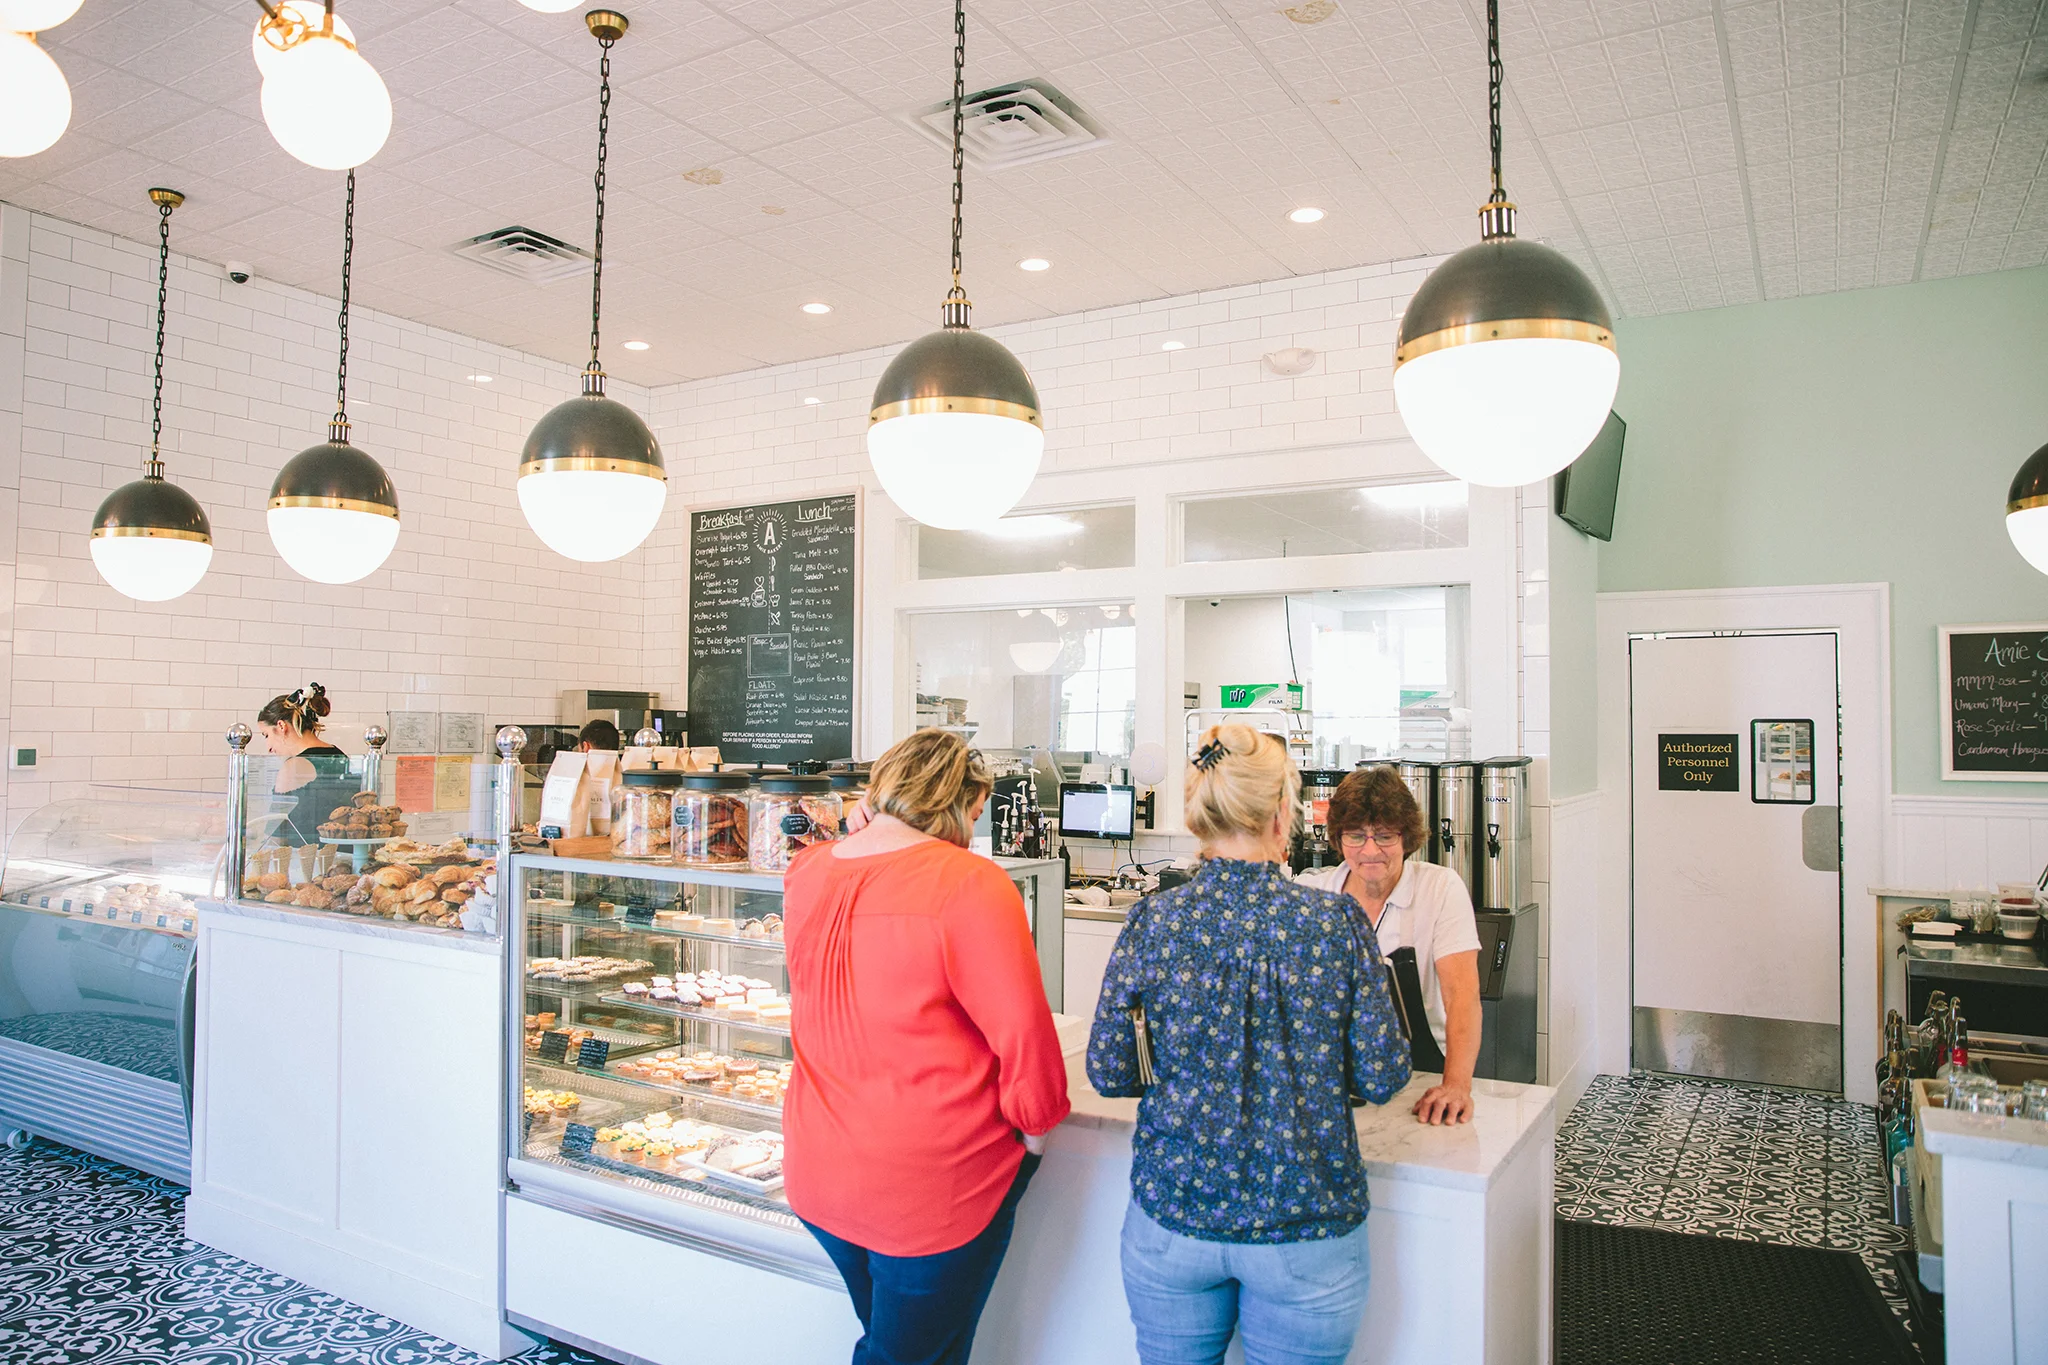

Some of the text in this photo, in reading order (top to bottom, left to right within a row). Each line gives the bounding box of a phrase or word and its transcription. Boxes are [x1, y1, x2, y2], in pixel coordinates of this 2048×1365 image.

[798, 501, 830, 520] Lunch
[699, 510, 743, 529] Breakfast
[764, 522, 776, 545] A
[809, 548, 821, 557] Melt
[722, 558, 734, 566] Tart
[694, 572, 716, 581] Waffles
[804, 572, 824, 580] Sandwich
[695, 625, 711, 634] Quiche
[791, 624, 800, 633] Egg
[801, 624, 814, 632] Salad
[693, 637, 705, 645] Two
[706, 636, 722, 645] Baked
[711, 646, 725, 655] Hash
[1984, 637, 2030, 667] Amie
[749, 681, 776, 689] FLOATS
[793, 693, 807, 701] Salad
[1955, 698, 1989, 711] Umami
[1992, 696, 2019, 714] Mary
[1986, 718, 2021, 737] Spritz
[1663, 743, 1732, 753] Authorized
[1958, 742, 2010, 758] Cardamom
[1667, 757, 1729, 768] Personnel
[1683, 771, 1713, 784] Only
